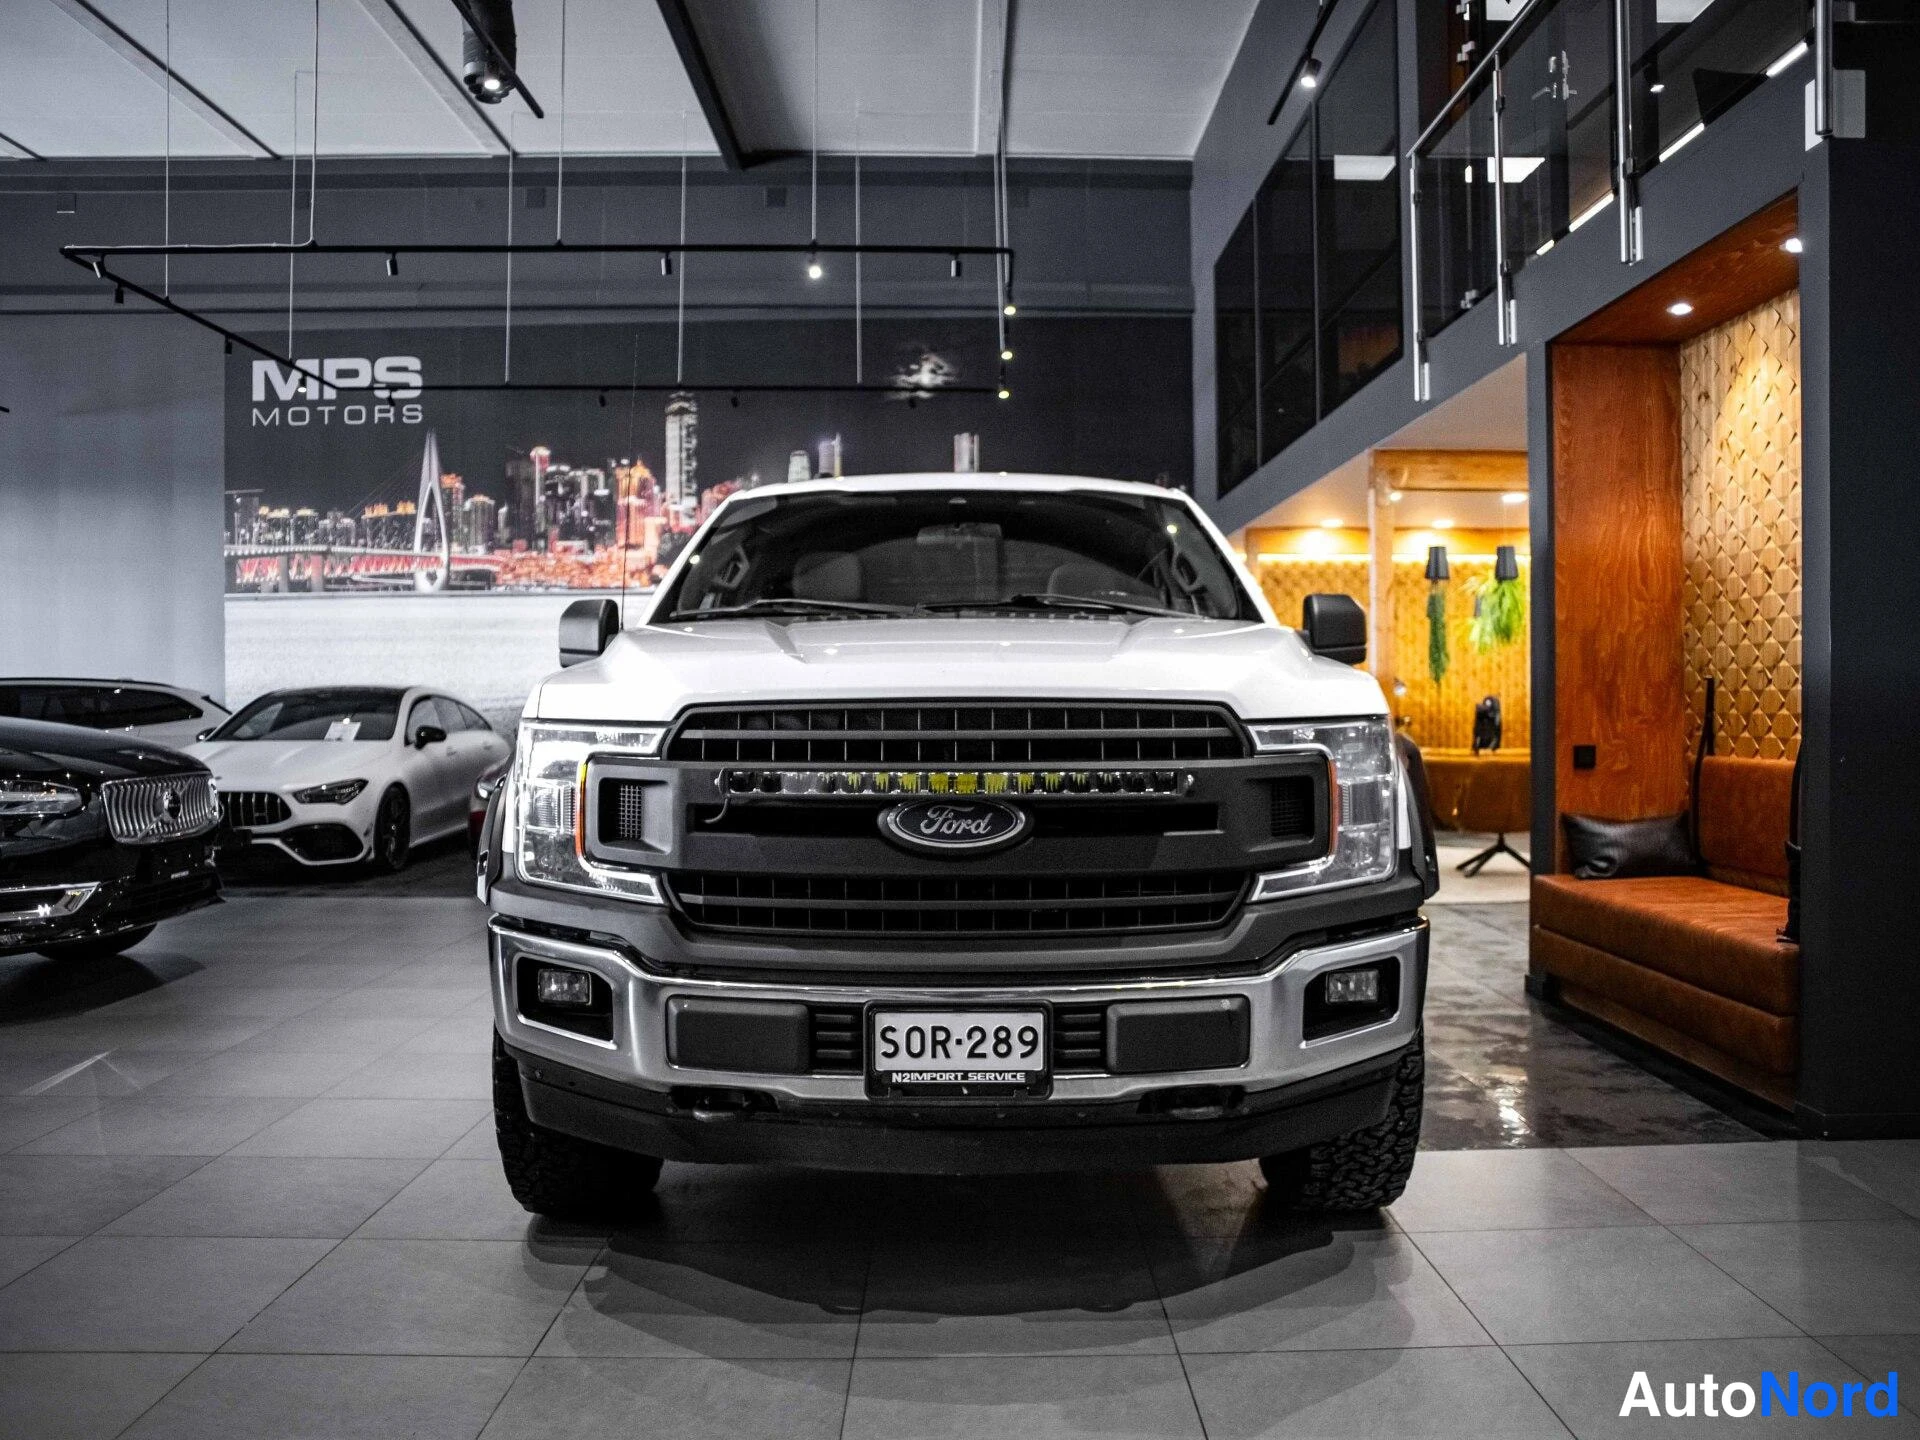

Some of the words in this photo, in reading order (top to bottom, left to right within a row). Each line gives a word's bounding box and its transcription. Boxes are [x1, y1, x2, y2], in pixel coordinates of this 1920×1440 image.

[252, 356, 423, 402] MPS
[252, 404, 423, 427] MOTORS
[920, 805, 993, 835] Ford
[967, 1072, 1026, 1082] SERVICE
